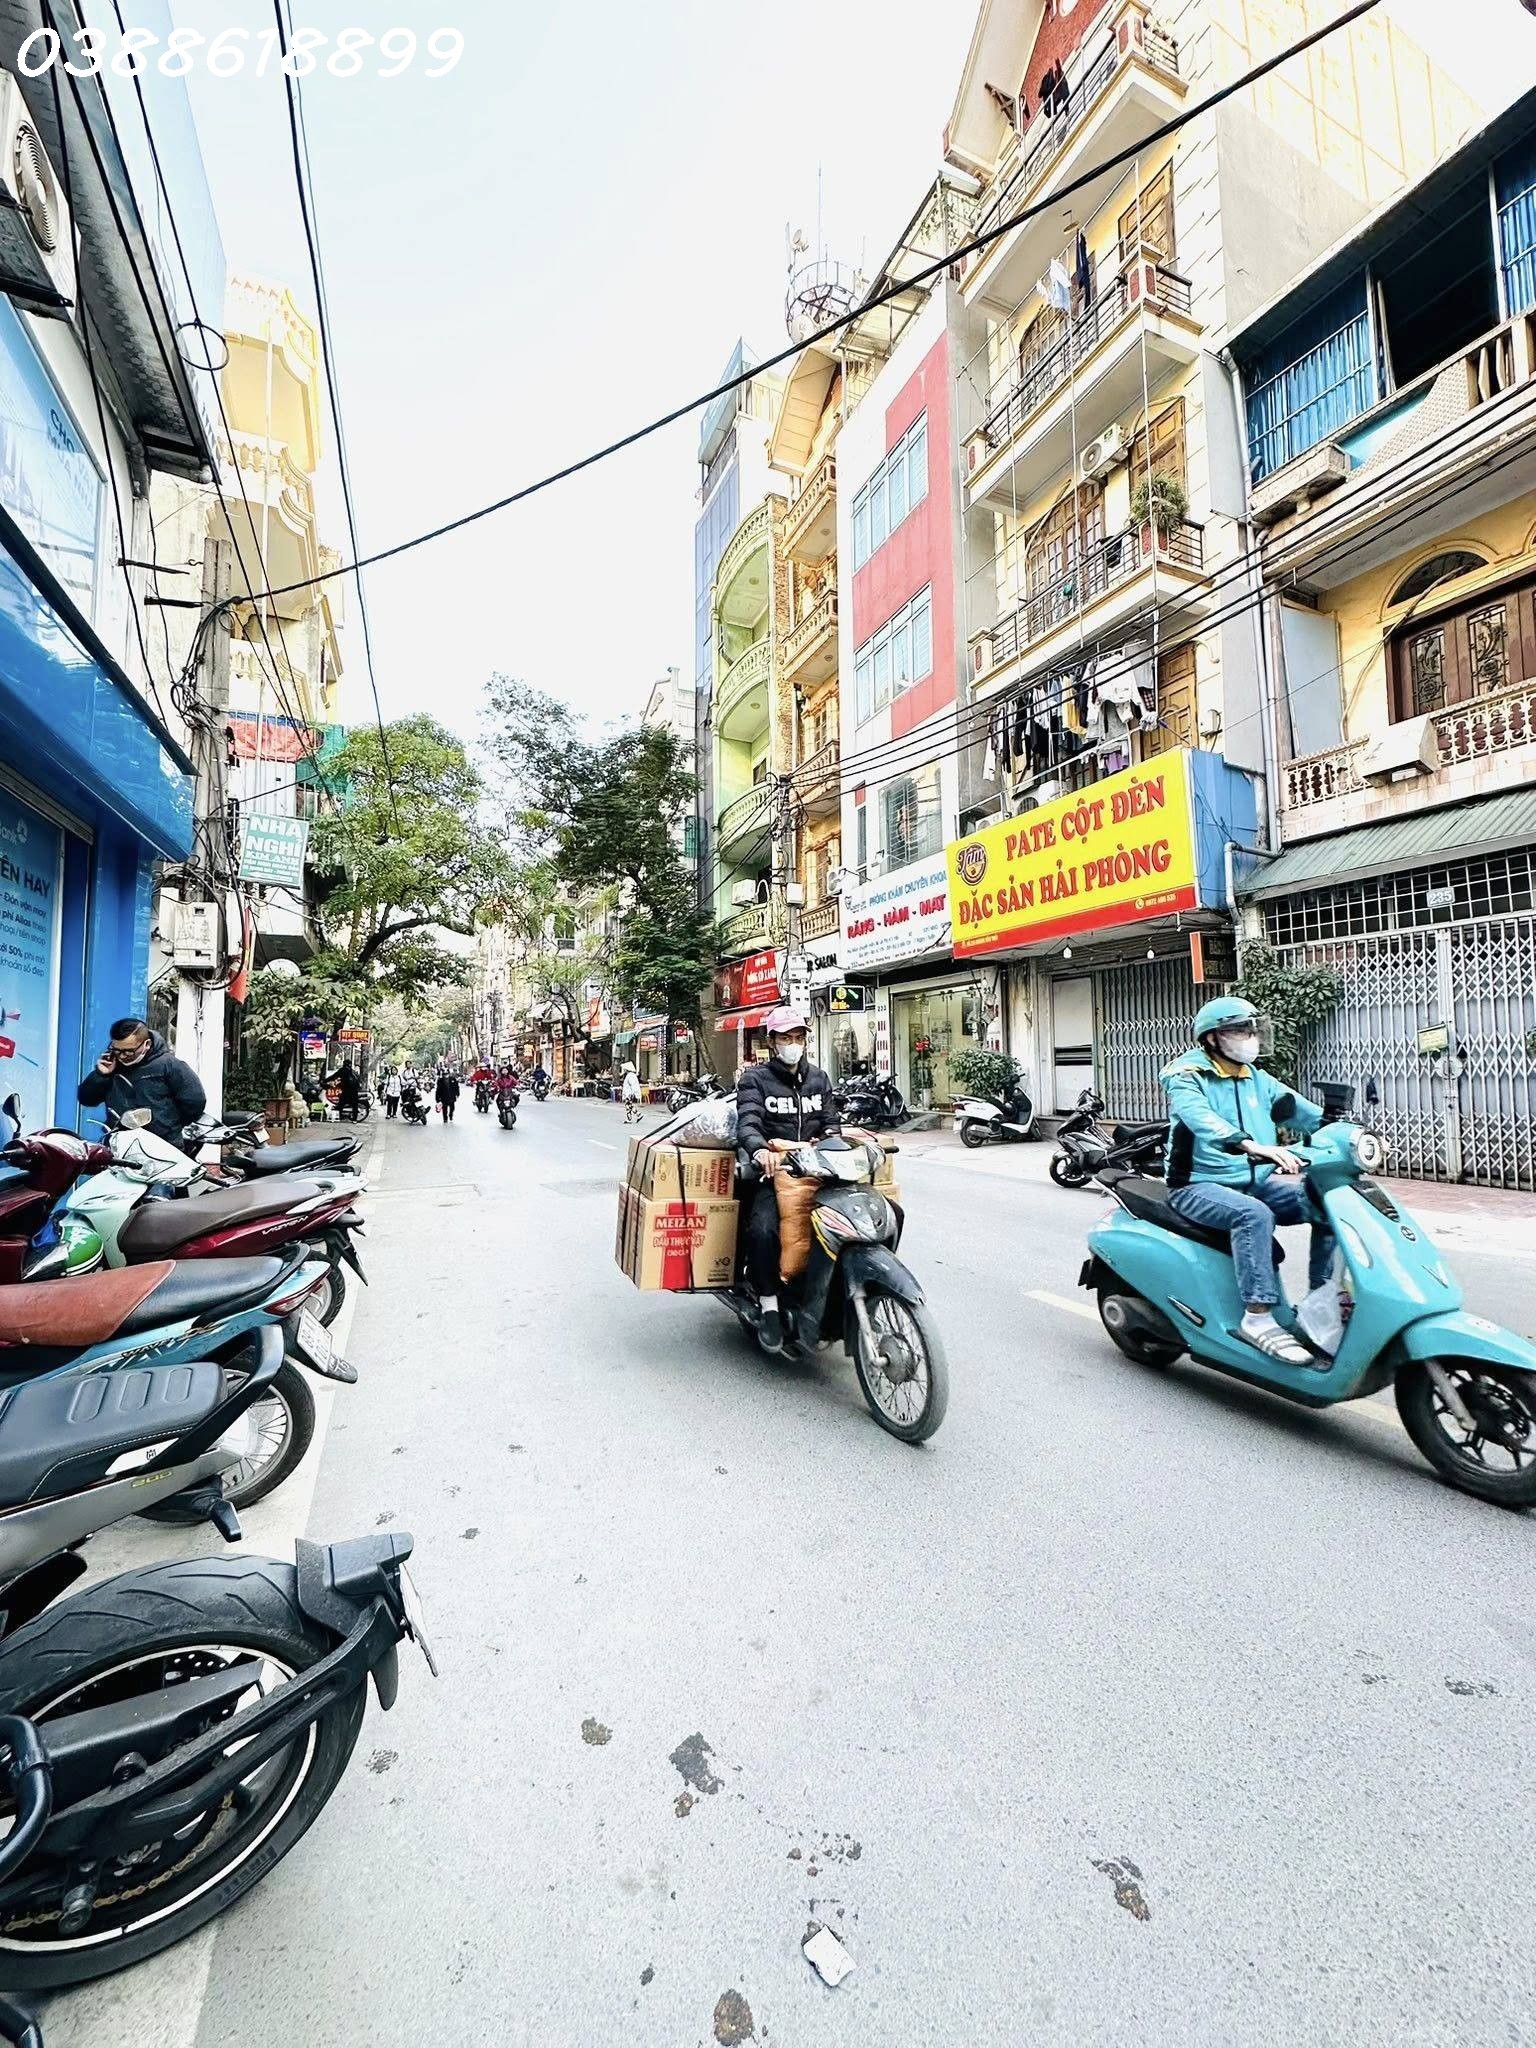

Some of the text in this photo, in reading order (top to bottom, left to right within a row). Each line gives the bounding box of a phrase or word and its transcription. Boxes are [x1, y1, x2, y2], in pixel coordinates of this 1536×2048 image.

[1004, 775, 1165, 862] PATE CỘT ĐÈN
[959, 838, 1172, 929] ĐẶC SẢN HẢI PHÒNG
[1429, 891, 1452, 904] 235
[883, 906, 910, 928] HÀM
[9, 945, 23, 958] 50%
[655, 1217, 706, 1230] MEIZAN
